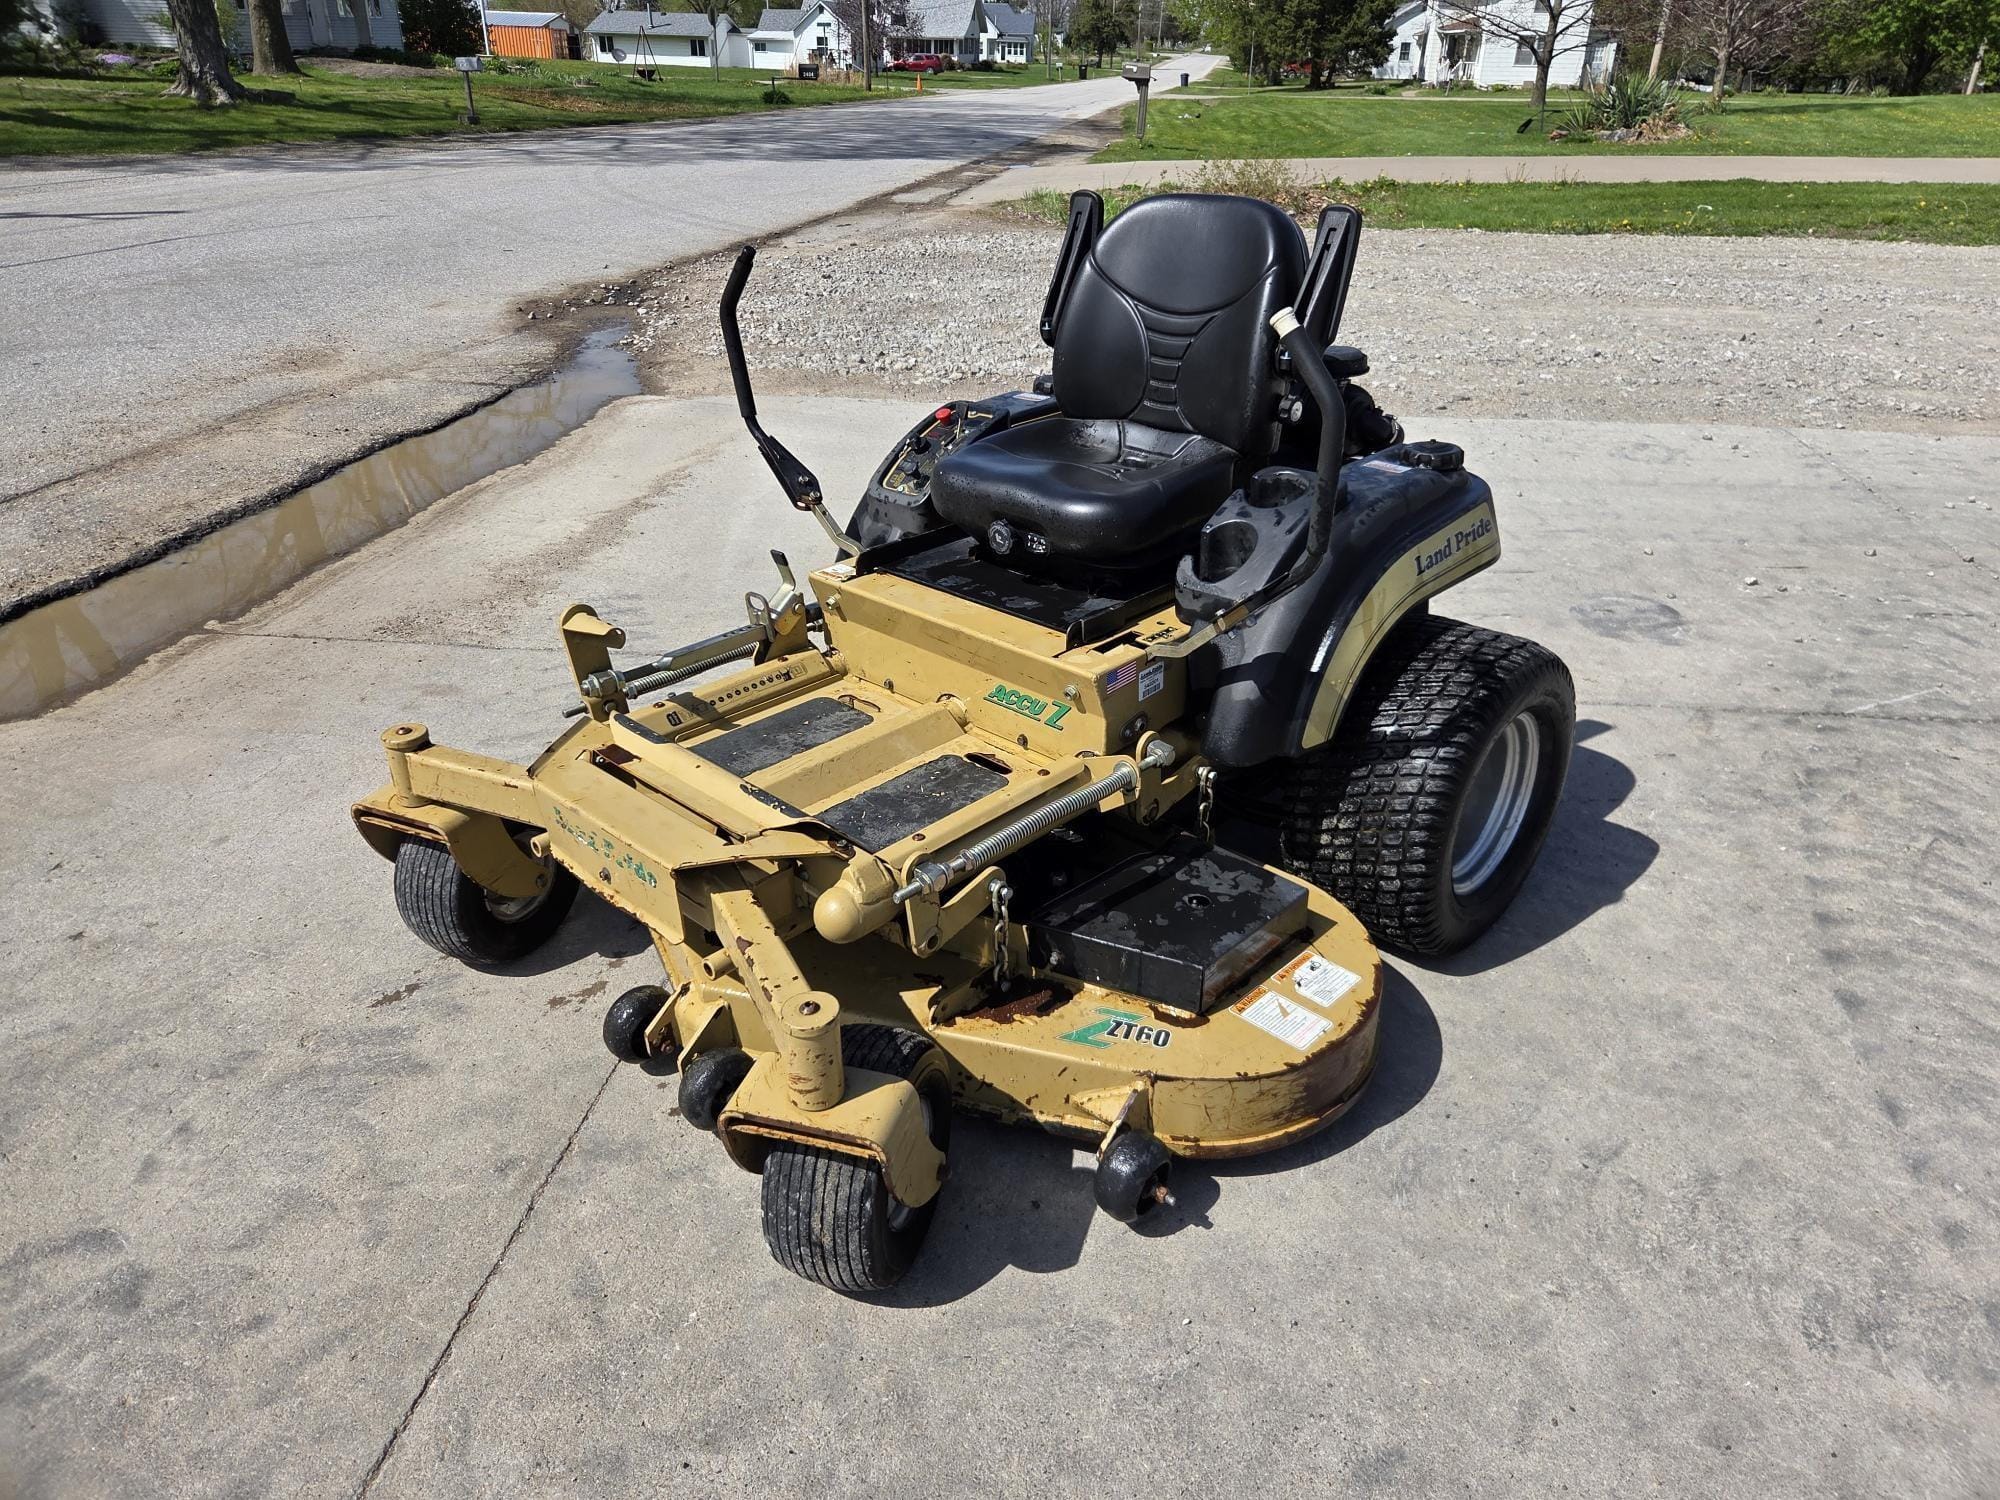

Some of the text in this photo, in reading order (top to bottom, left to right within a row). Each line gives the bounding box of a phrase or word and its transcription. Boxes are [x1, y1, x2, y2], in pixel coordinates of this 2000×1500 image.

[1414, 518, 1493, 576] Land Pride
[987, 684, 1072, 731] ACCU Z
[1105, 1018, 1172, 1048] ZT60
